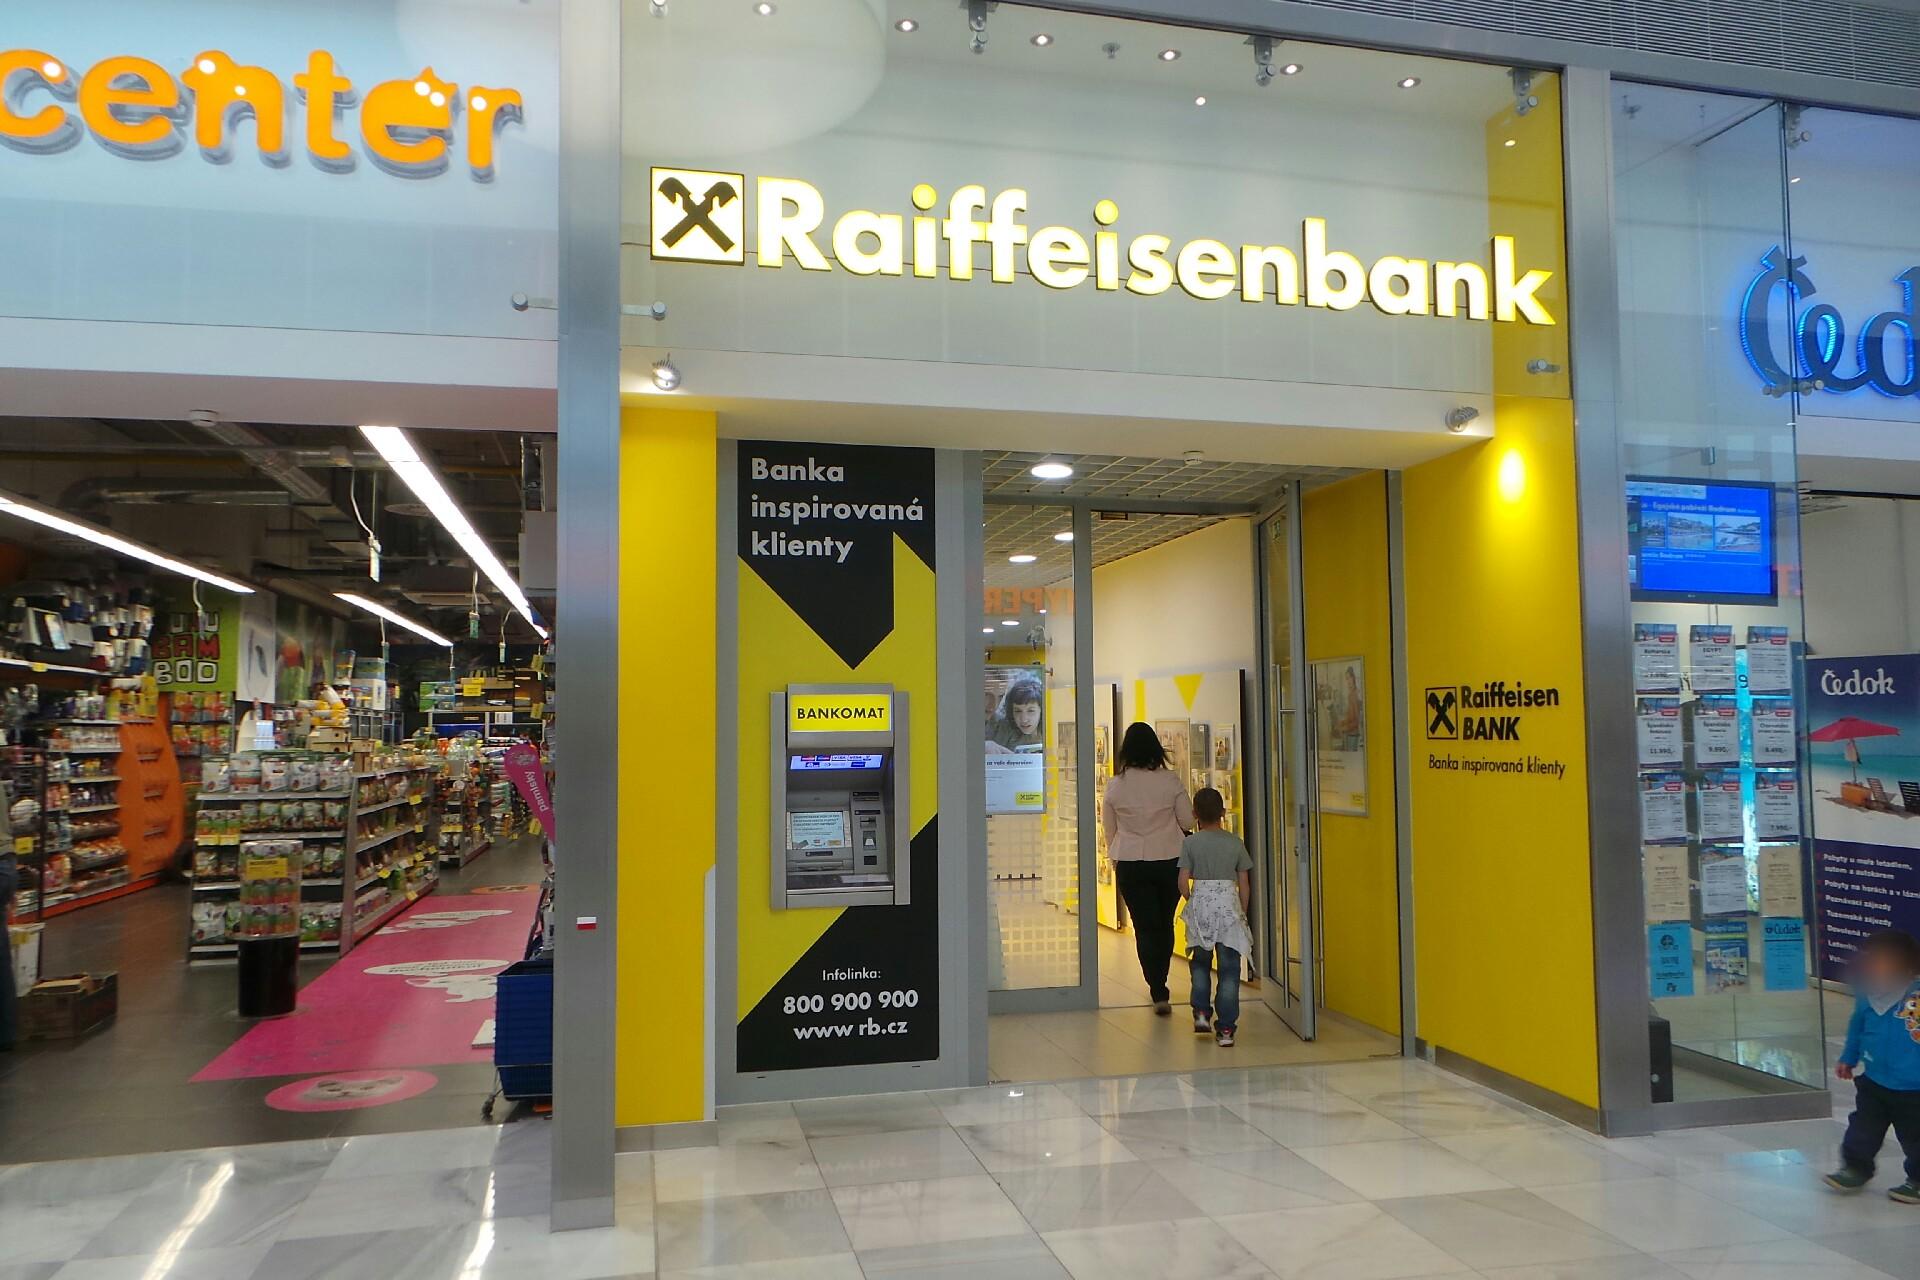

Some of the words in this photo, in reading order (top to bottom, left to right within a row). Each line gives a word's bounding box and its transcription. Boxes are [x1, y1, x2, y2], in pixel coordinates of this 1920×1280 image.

[0, 48, 523, 170] center
[756, 174, 1556, 326] Raiffeisenbank
[751, 457, 844, 482] Banka
[751, 494, 923, 525] inspirovaná
[751, 530, 854, 563] klienty
[153, 659, 219, 685] BOO
[1821, 668, 1897, 696] Čedok
[1461, 681, 1559, 709] Raiffeisen
[797, 707, 885, 720] BANKOMAT
[1463, 717, 1521, 741] BANK
[1429, 754, 1459, 771] Banka
[1462, 755, 1524, 776] inspirovaná
[1527, 755, 1566, 780] klienty
[1823, 853, 1848, 864] Pobyty
[1824, 879, 1849, 890] Pobyty
[823, 967, 882, 981] Infolinka:
[783, 994, 824, 1015] 800
[831, 991, 872, 1011] 900
[878, 989, 919, 1008] 900
